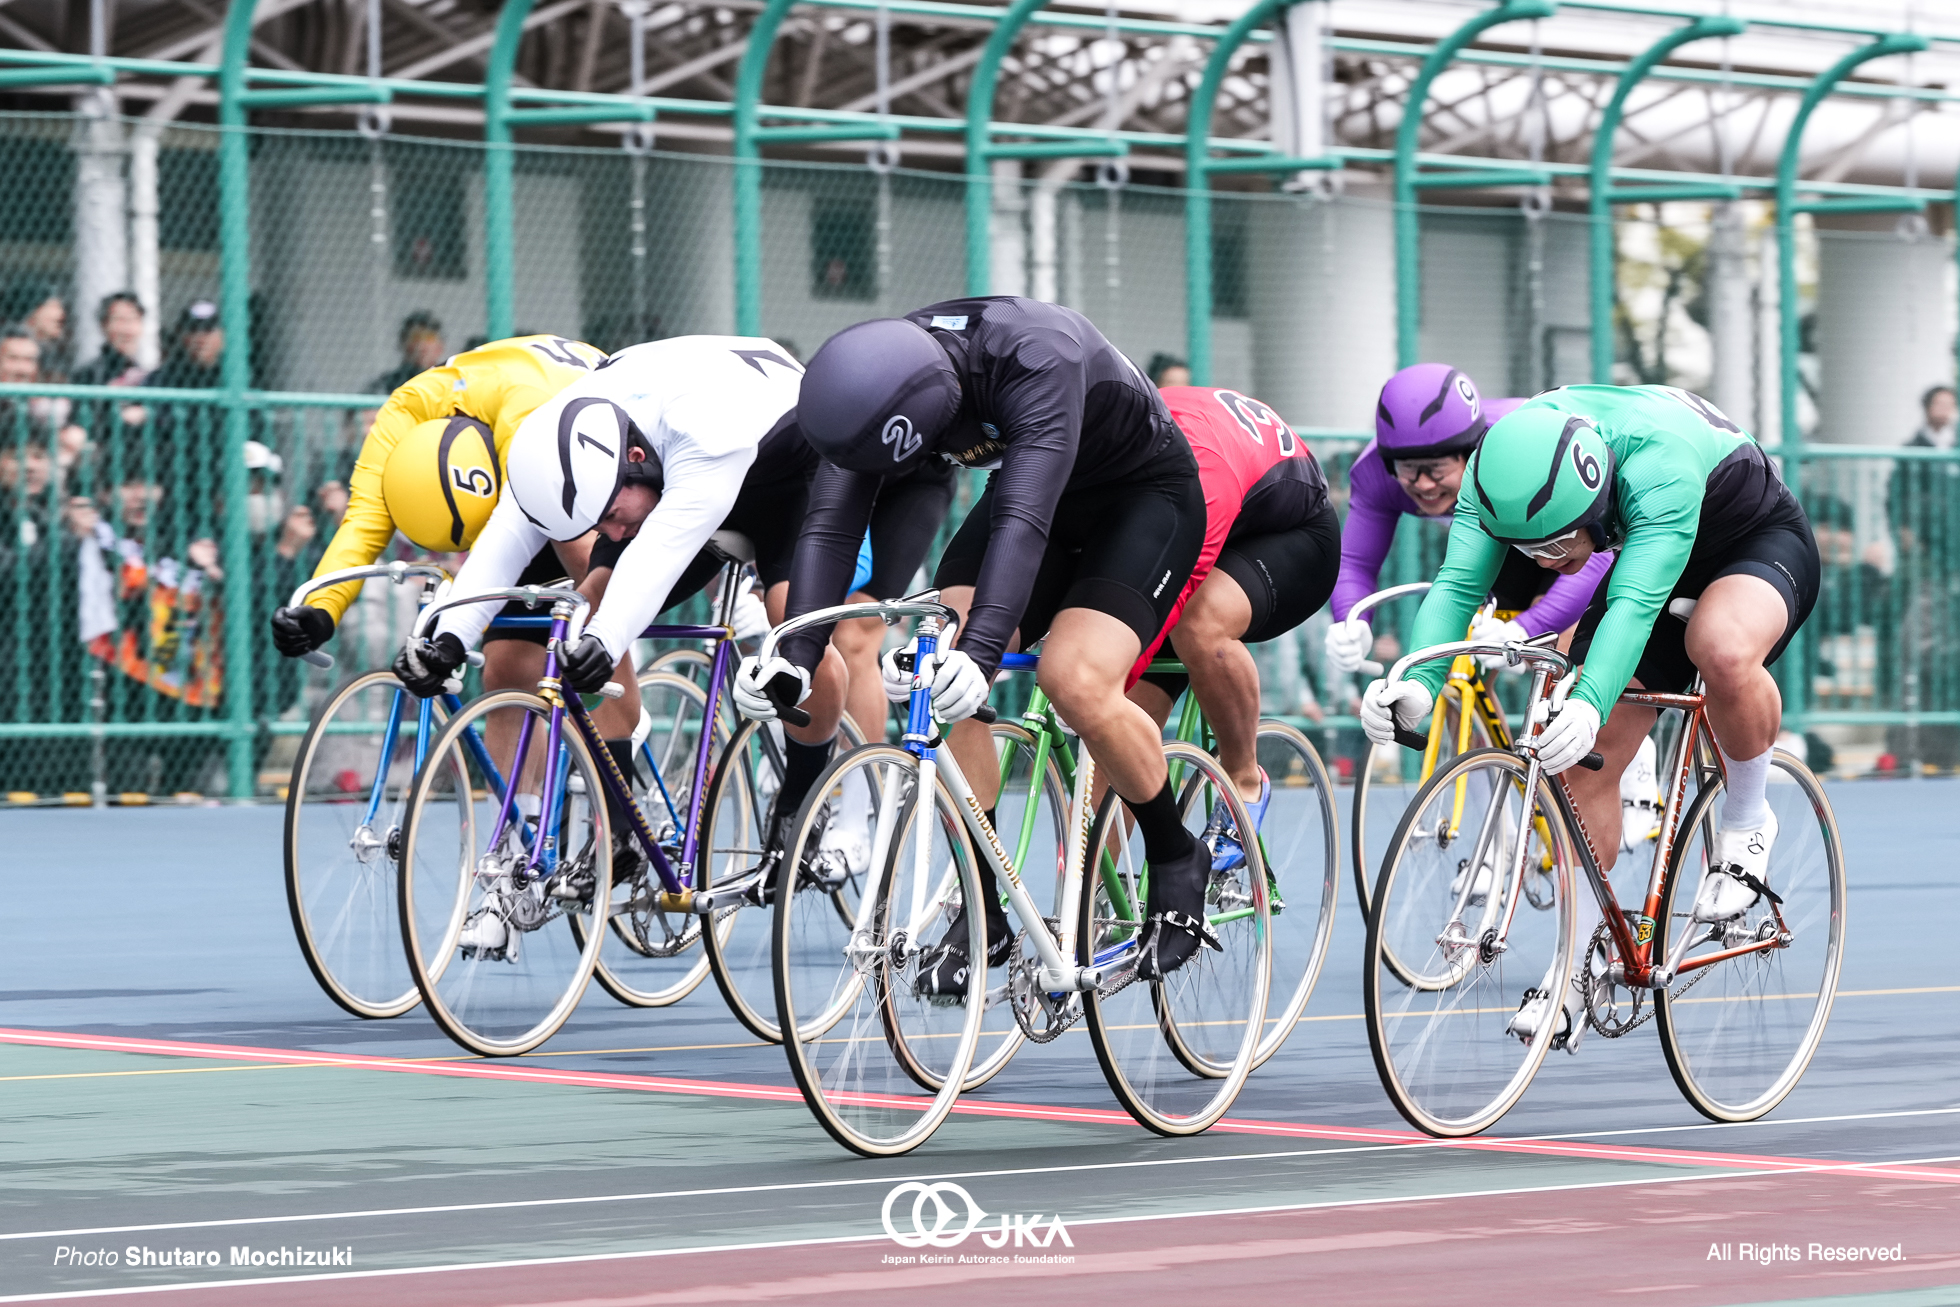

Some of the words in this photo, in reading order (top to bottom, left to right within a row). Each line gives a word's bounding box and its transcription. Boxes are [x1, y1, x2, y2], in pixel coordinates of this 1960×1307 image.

[1213, 389, 1296, 457] 3
[1455, 375, 1480, 422] 9
[577, 431, 615, 459] 1
[881, 414, 923, 463] 2
[448, 465, 495, 498] 5
[1570, 439, 1602, 492] 6
[965, 796, 1021, 890] BRIDGESTONE
